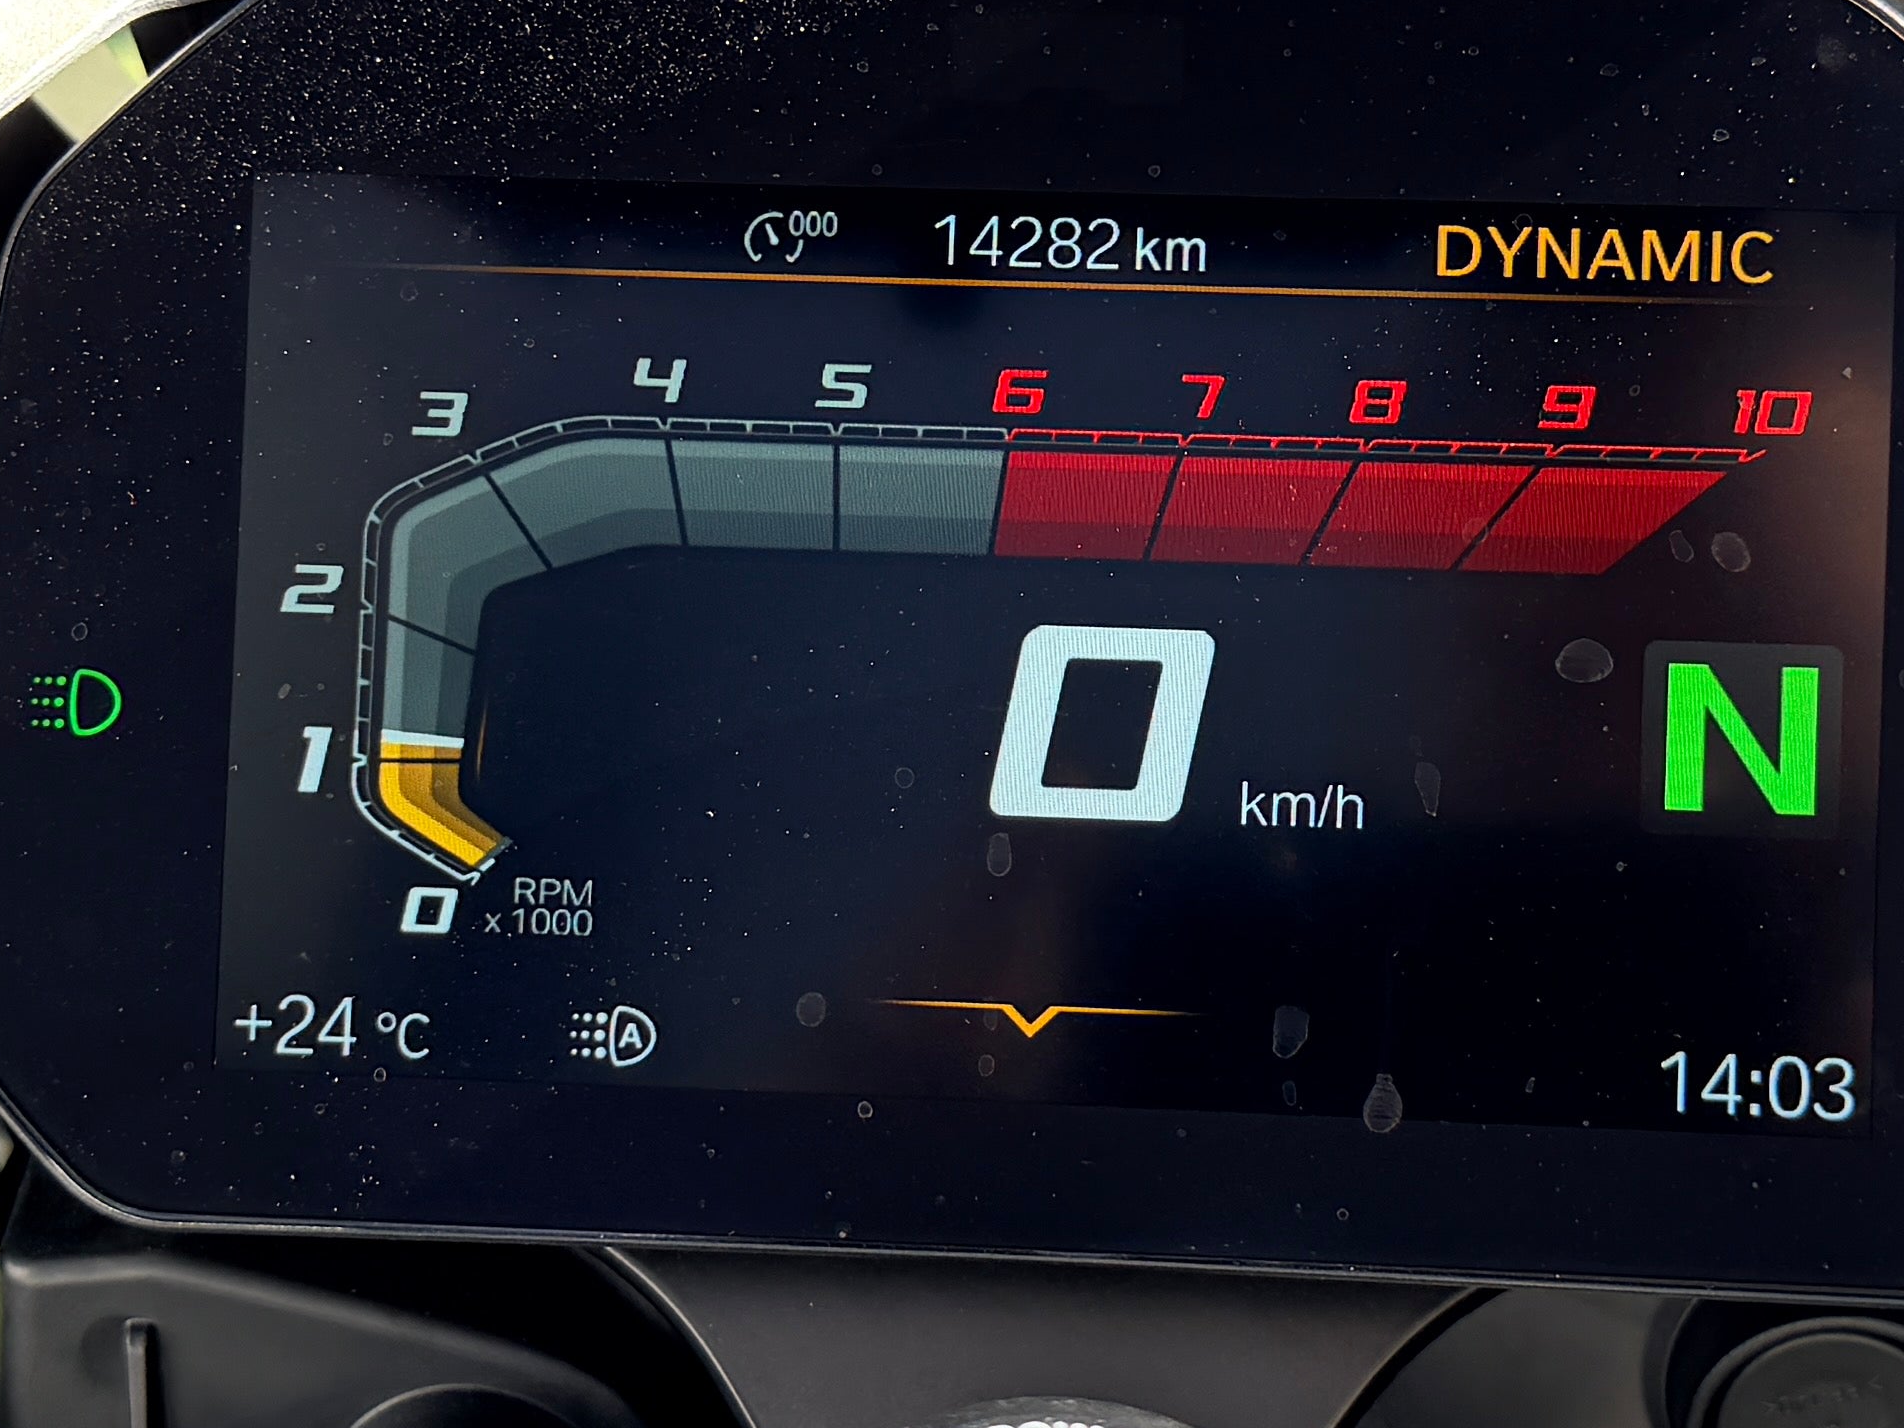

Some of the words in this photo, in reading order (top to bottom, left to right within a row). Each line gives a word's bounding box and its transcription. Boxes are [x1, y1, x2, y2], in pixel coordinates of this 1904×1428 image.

[934, 213, 1121, 271] 14282
[1134, 226, 1208, 273] km
[1435, 224, 1776, 285] DYNAMIC
[633, 358, 688, 404] 4
[814, 363, 873, 410] 5
[992, 369, 1050, 414] 6
[1181, 373, 1227, 419] 7
[1348, 379, 1408, 425] 8
[411, 391, 469, 437] 3
[1537, 384, 1597, 430] 9
[1731, 388, 1814, 436] 10
[280, 563, 345, 614] 2
[988, 624, 1217, 823] 0
[1663, 662, 1820, 818] N
[296, 726, 332, 794] 1
[1239, 779, 1366, 831] km/h
[399, 885, 460, 936] 0
[513, 876, 595, 908] RPM
[510, 908, 595, 938] 1000
[234, 993, 358, 1057] +24
[1659, 1049, 1858, 1123] 14:03
